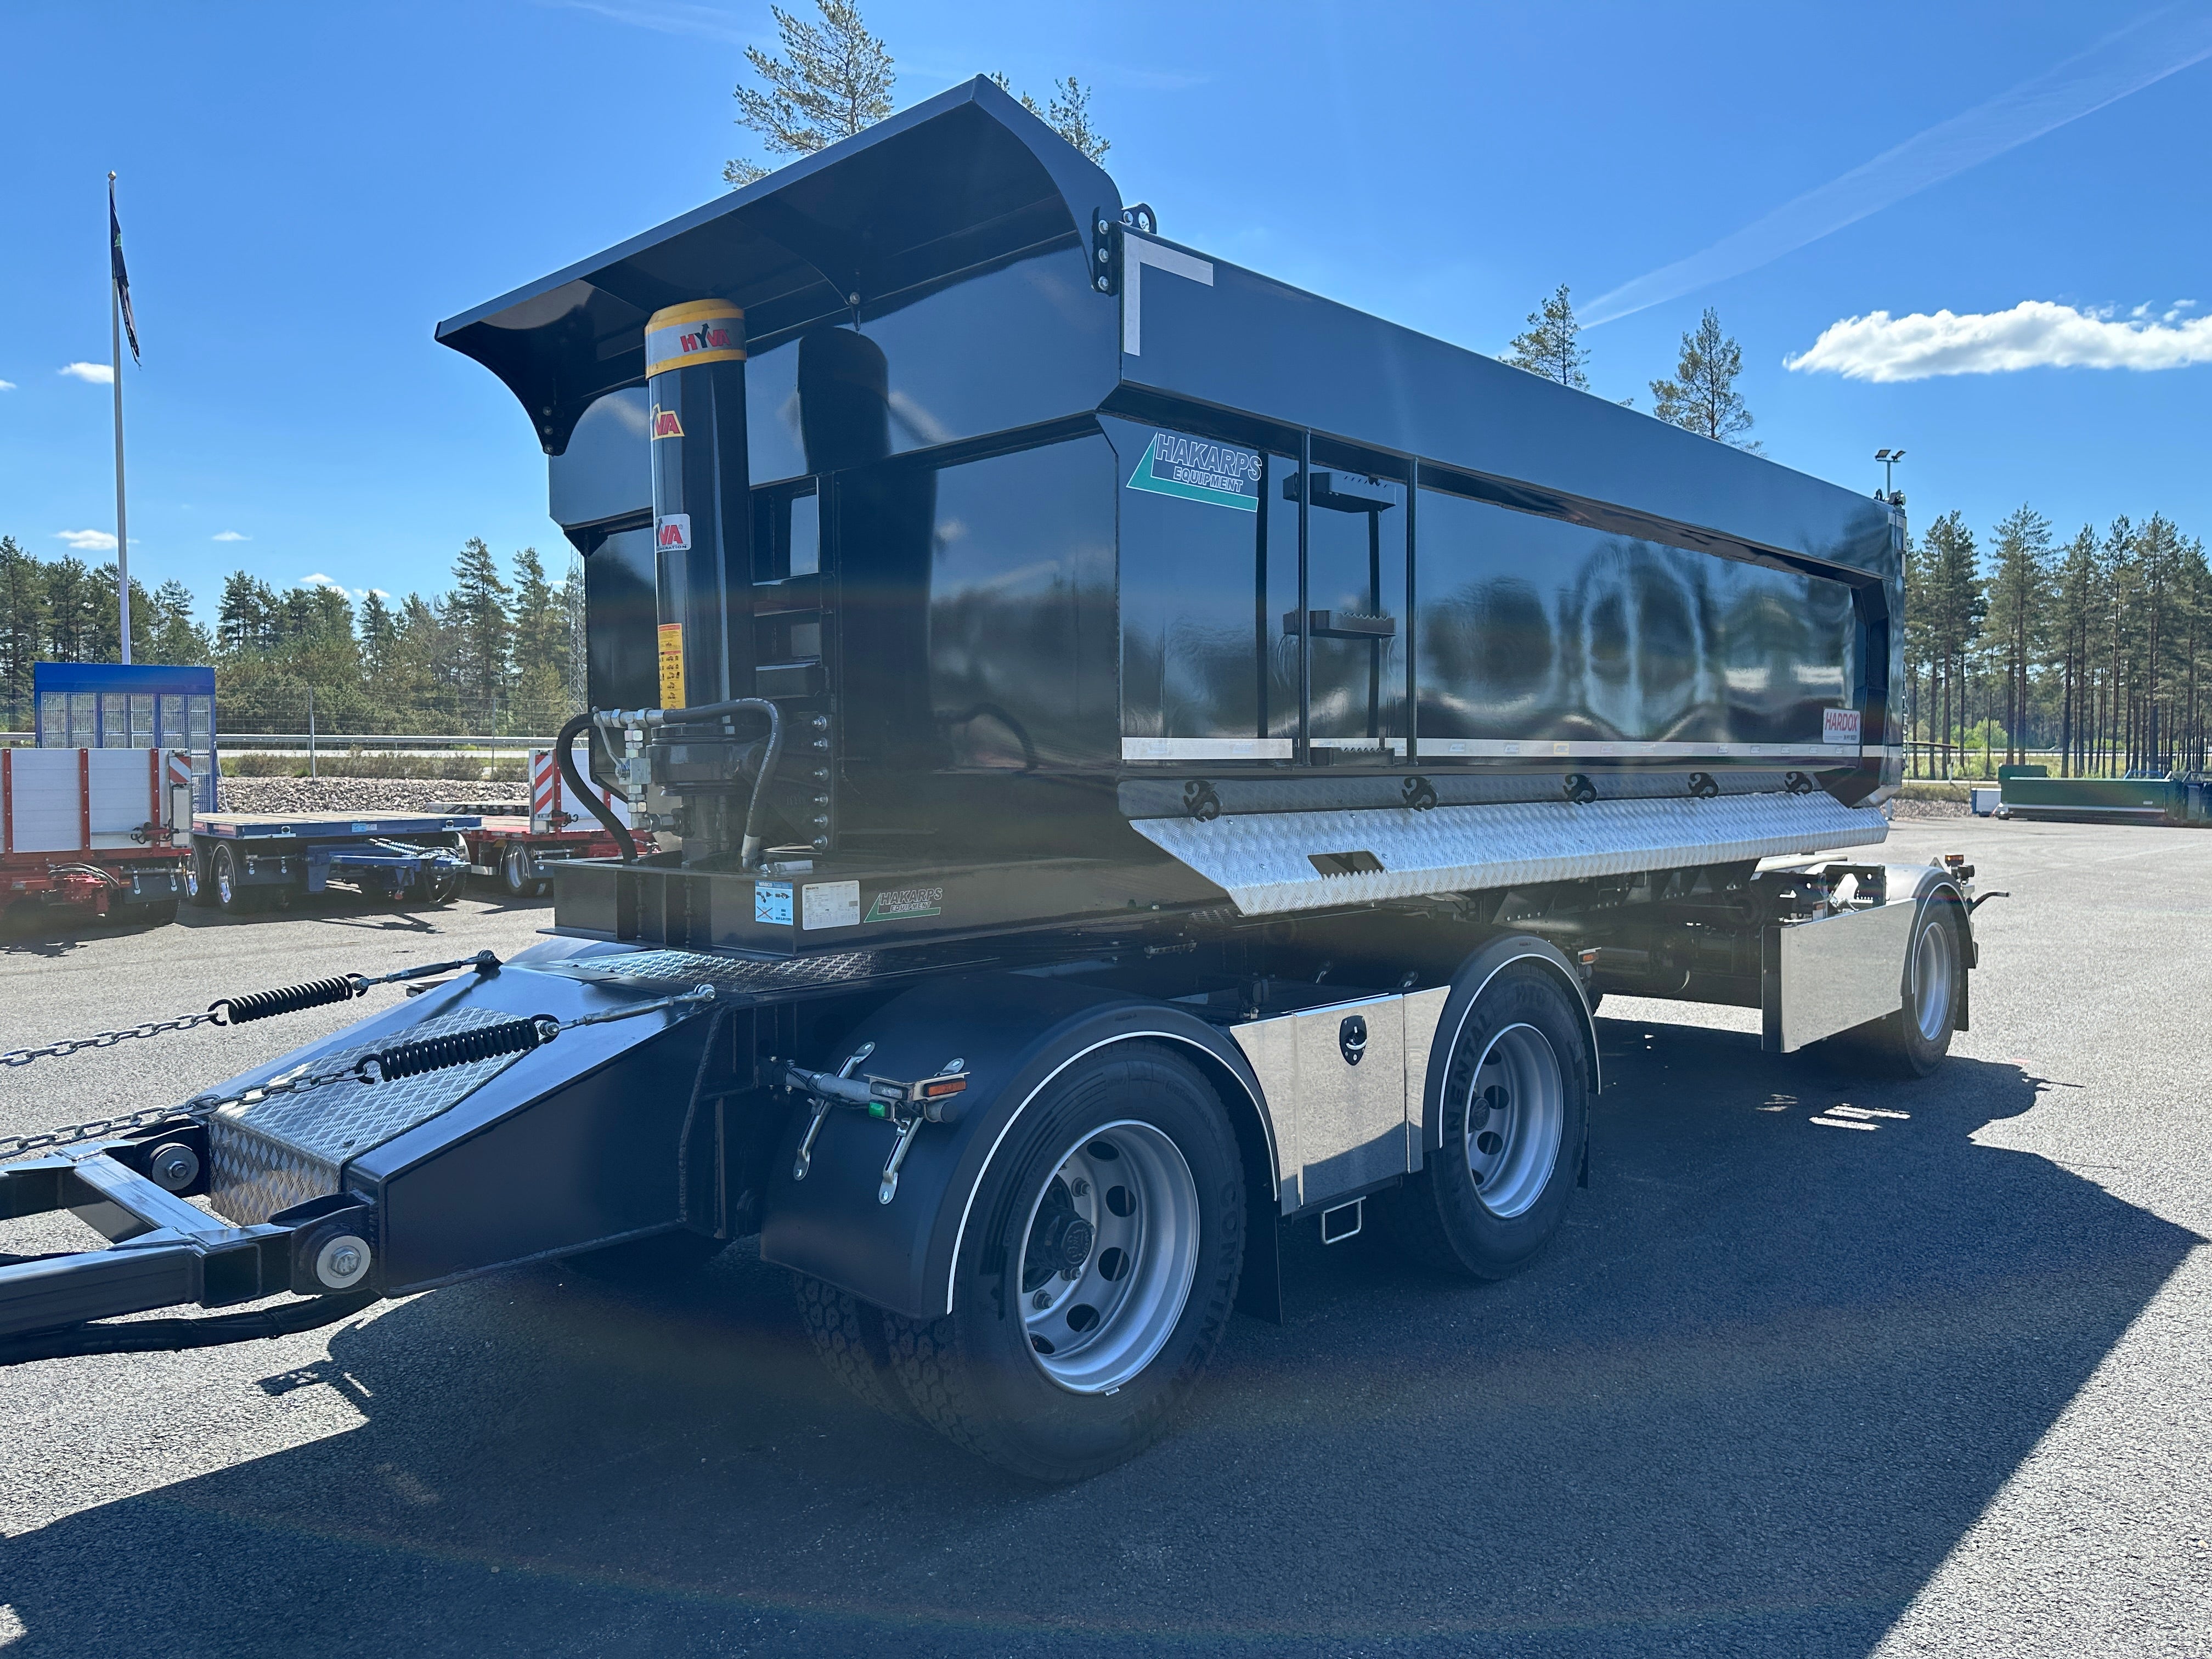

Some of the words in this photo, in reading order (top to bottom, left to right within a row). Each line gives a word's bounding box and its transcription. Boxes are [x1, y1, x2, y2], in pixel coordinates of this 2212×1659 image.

[680, 323, 732, 352] HYVA
[652, 407, 680, 438] VA
[1155, 433, 1262, 481] HAKARPS
[1173, 466, 1243, 493] EQUIPMENT
[657, 517, 684, 546] VA
[1825, 712, 1858, 732] HARDOX
[880, 888, 943, 905] HAKARPS
[890, 901, 932, 912] EQUIPMENT
